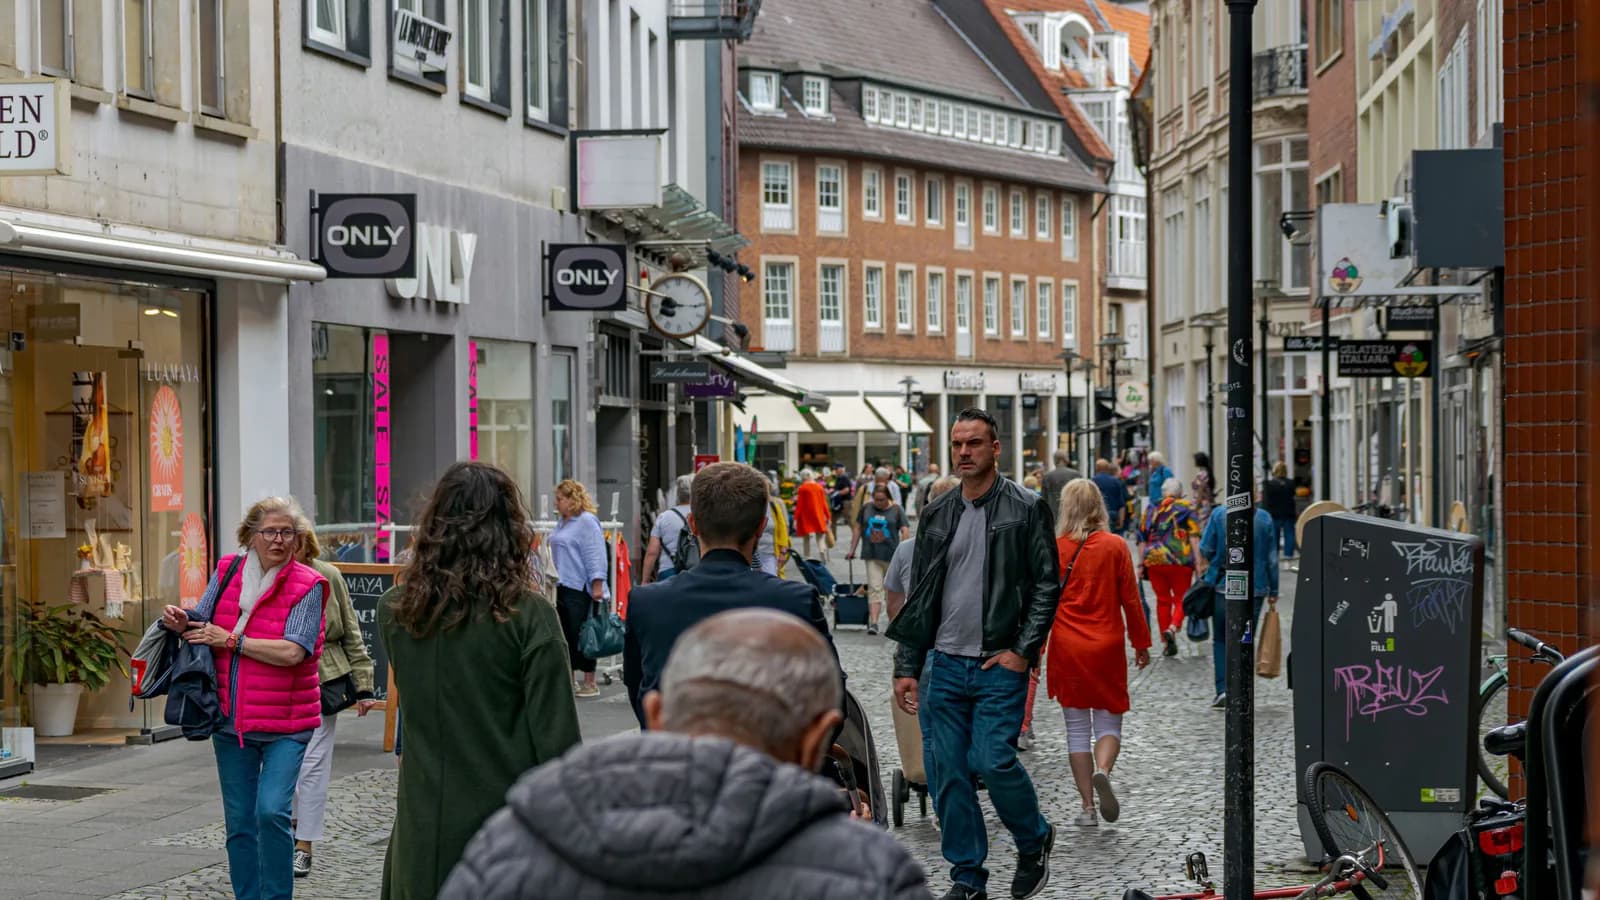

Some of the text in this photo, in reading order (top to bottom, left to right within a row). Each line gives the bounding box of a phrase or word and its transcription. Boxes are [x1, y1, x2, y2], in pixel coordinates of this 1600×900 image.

[327, 225, 404, 246] ONLY
[385, 222, 478, 304] NLY
[557, 268, 619, 286] ONLY
[1340, 345, 1396, 354] GELATERIA
[1340, 355, 1389, 363] ITALIANA
